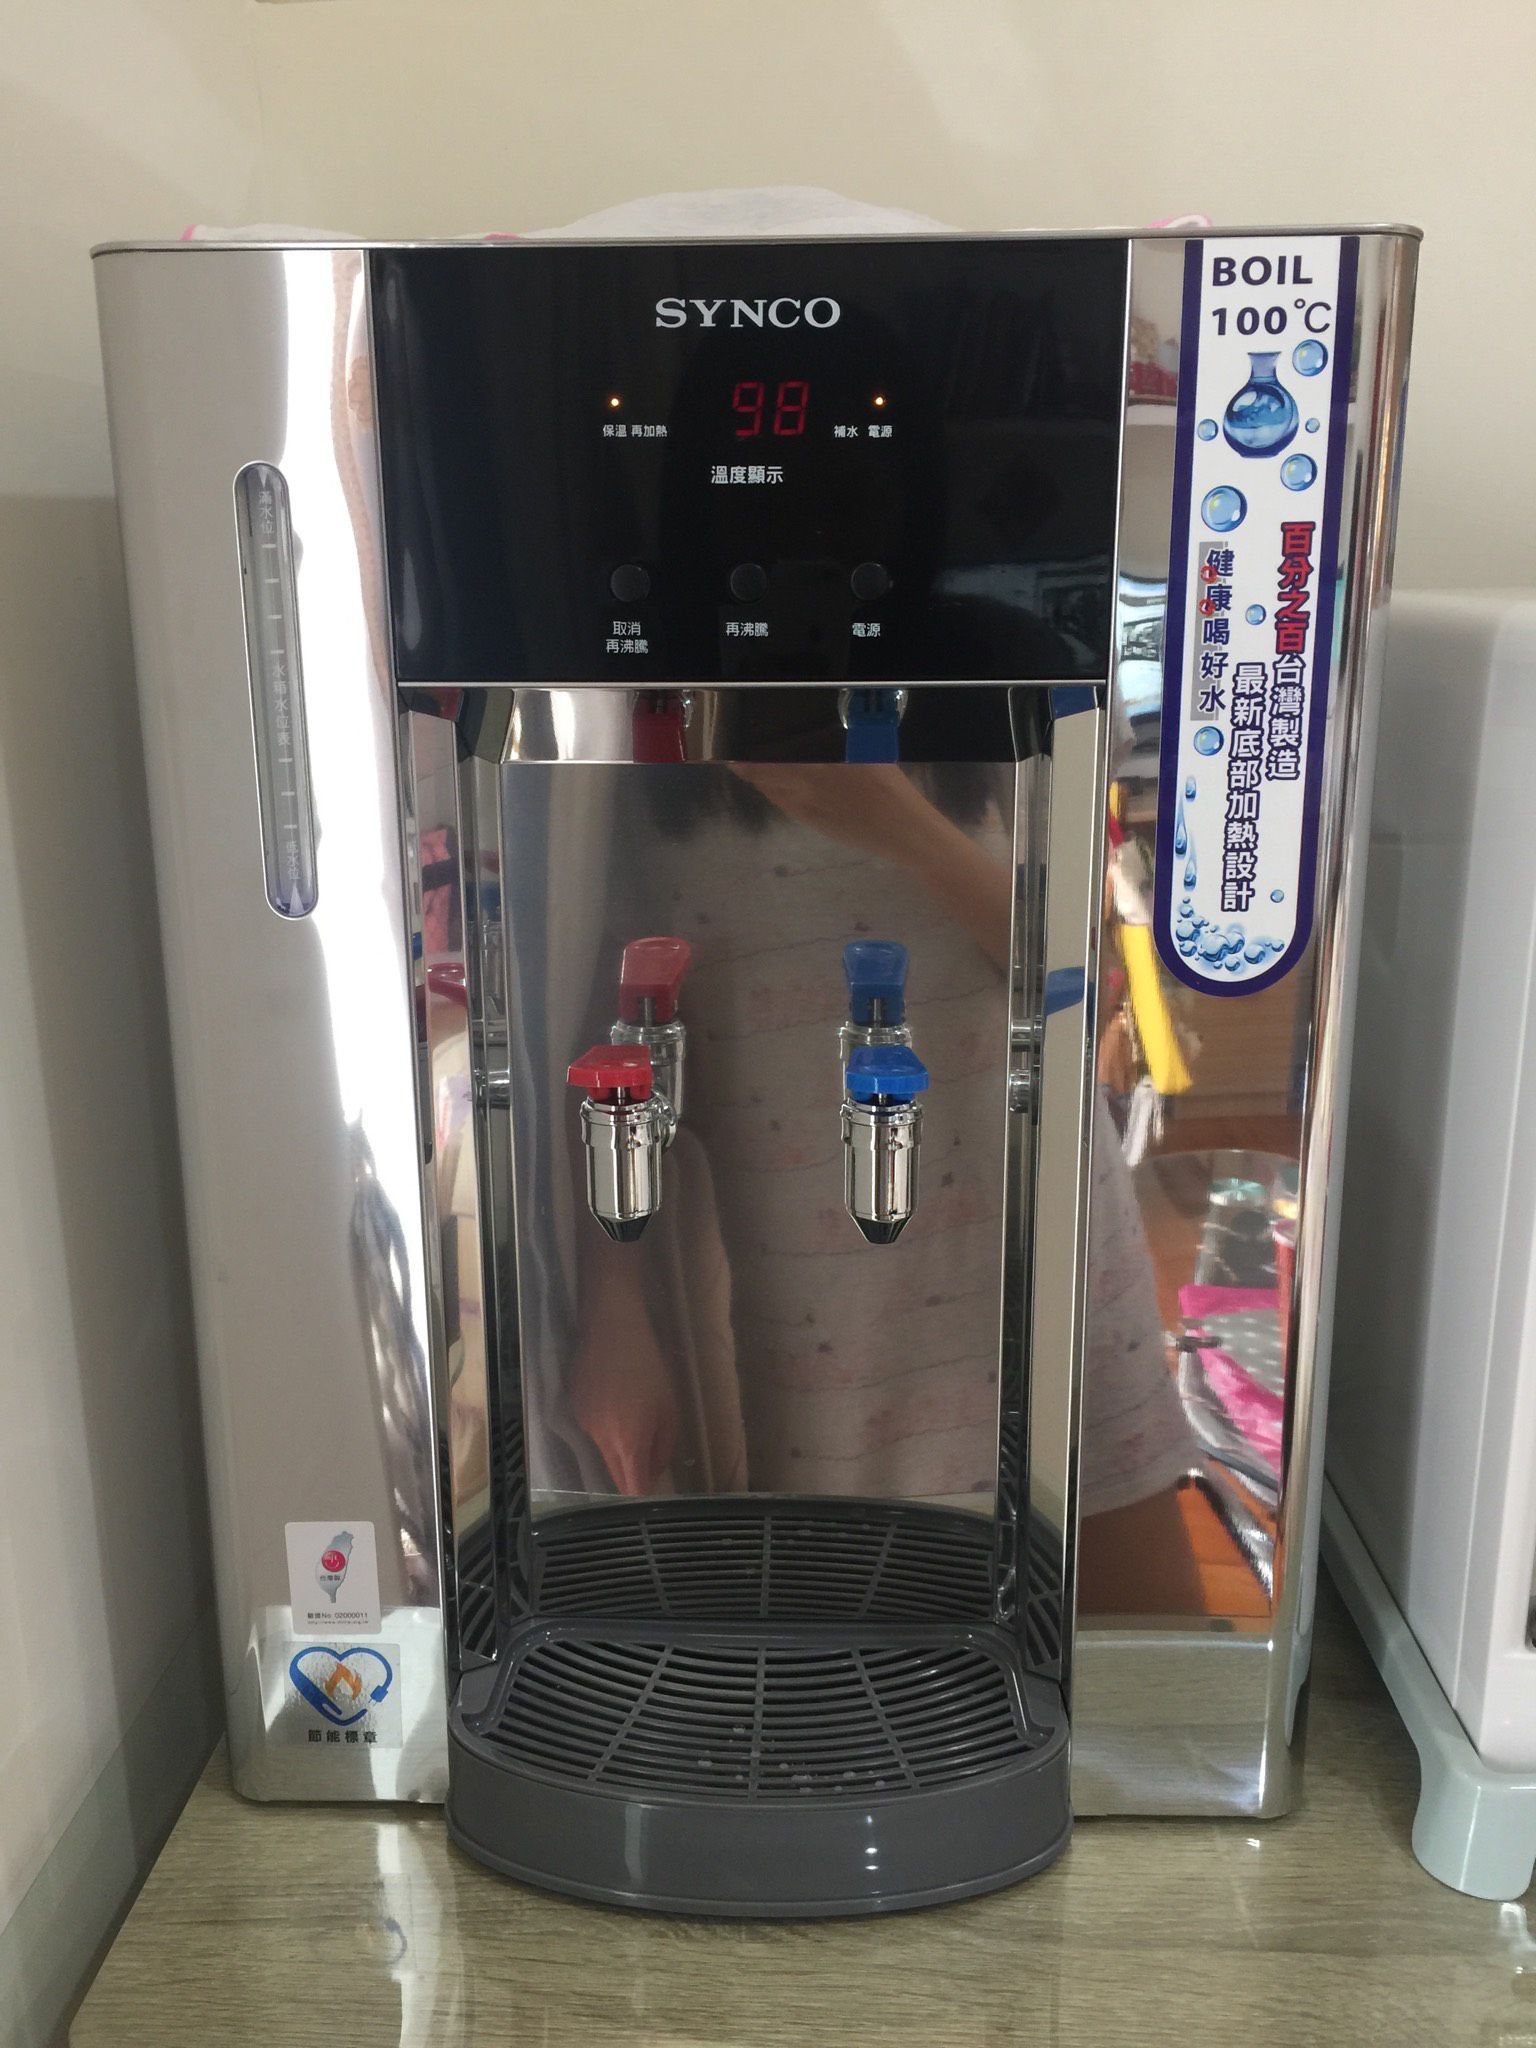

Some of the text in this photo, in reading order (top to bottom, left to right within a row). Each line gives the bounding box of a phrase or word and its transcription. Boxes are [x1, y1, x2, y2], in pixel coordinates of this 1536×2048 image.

[1212, 255, 1313, 287] BOIL
[655, 297, 841, 329] SYNCO
[732, 380, 810, 437] 98
[602, 424, 668, 437] 保溫 再加熱
[834, 424, 892, 438] 補水 電源
[711, 465, 784, 484] 溫度顯示
[612, 620, 641, 636] 取消
[725, 622, 769, 637] 再沸騰
[852, 622, 881, 637] 電源
[1199, 548, 1235, 714] 健康喝好水
[605, 639, 649, 654] 再沸騰
[1267, 521, 1316, 781] 百分之百台灣製造
[1221, 661, 1267, 914] 最新底部加熱設計
[308, 1730, 377, 1744] 節能標章
